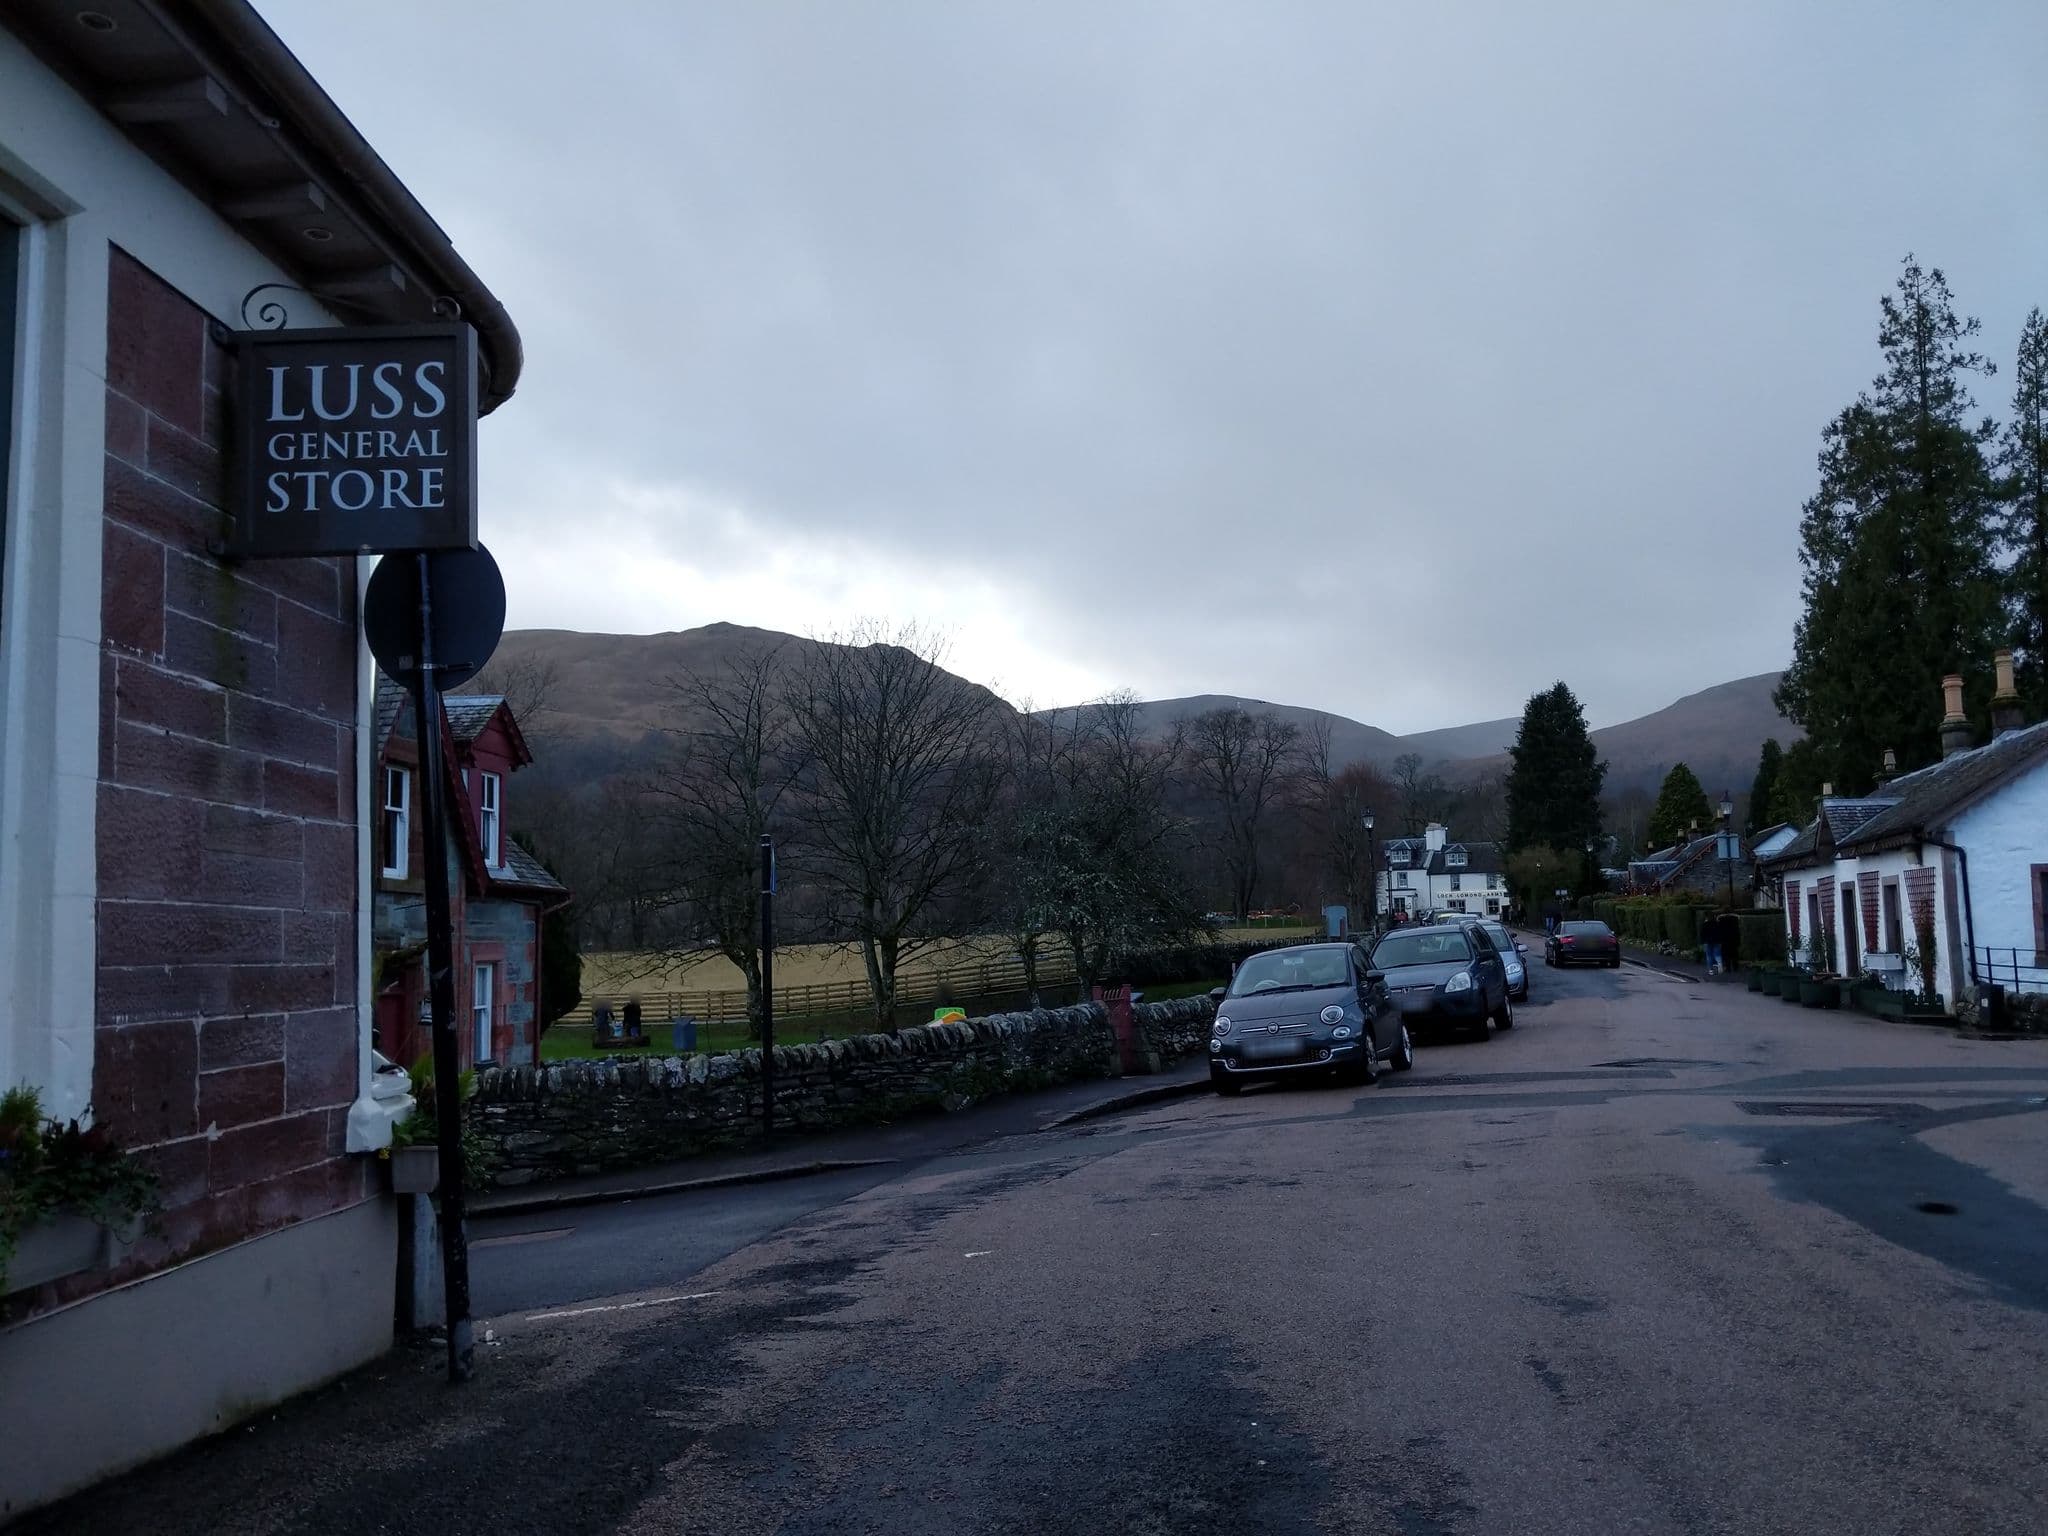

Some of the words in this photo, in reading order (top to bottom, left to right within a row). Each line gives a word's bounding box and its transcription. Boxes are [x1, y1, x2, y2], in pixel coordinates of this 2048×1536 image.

[266, 361, 447, 422] LUSS
[267, 429, 448, 461] GENERAL
[266, 467, 445, 513] STORE
